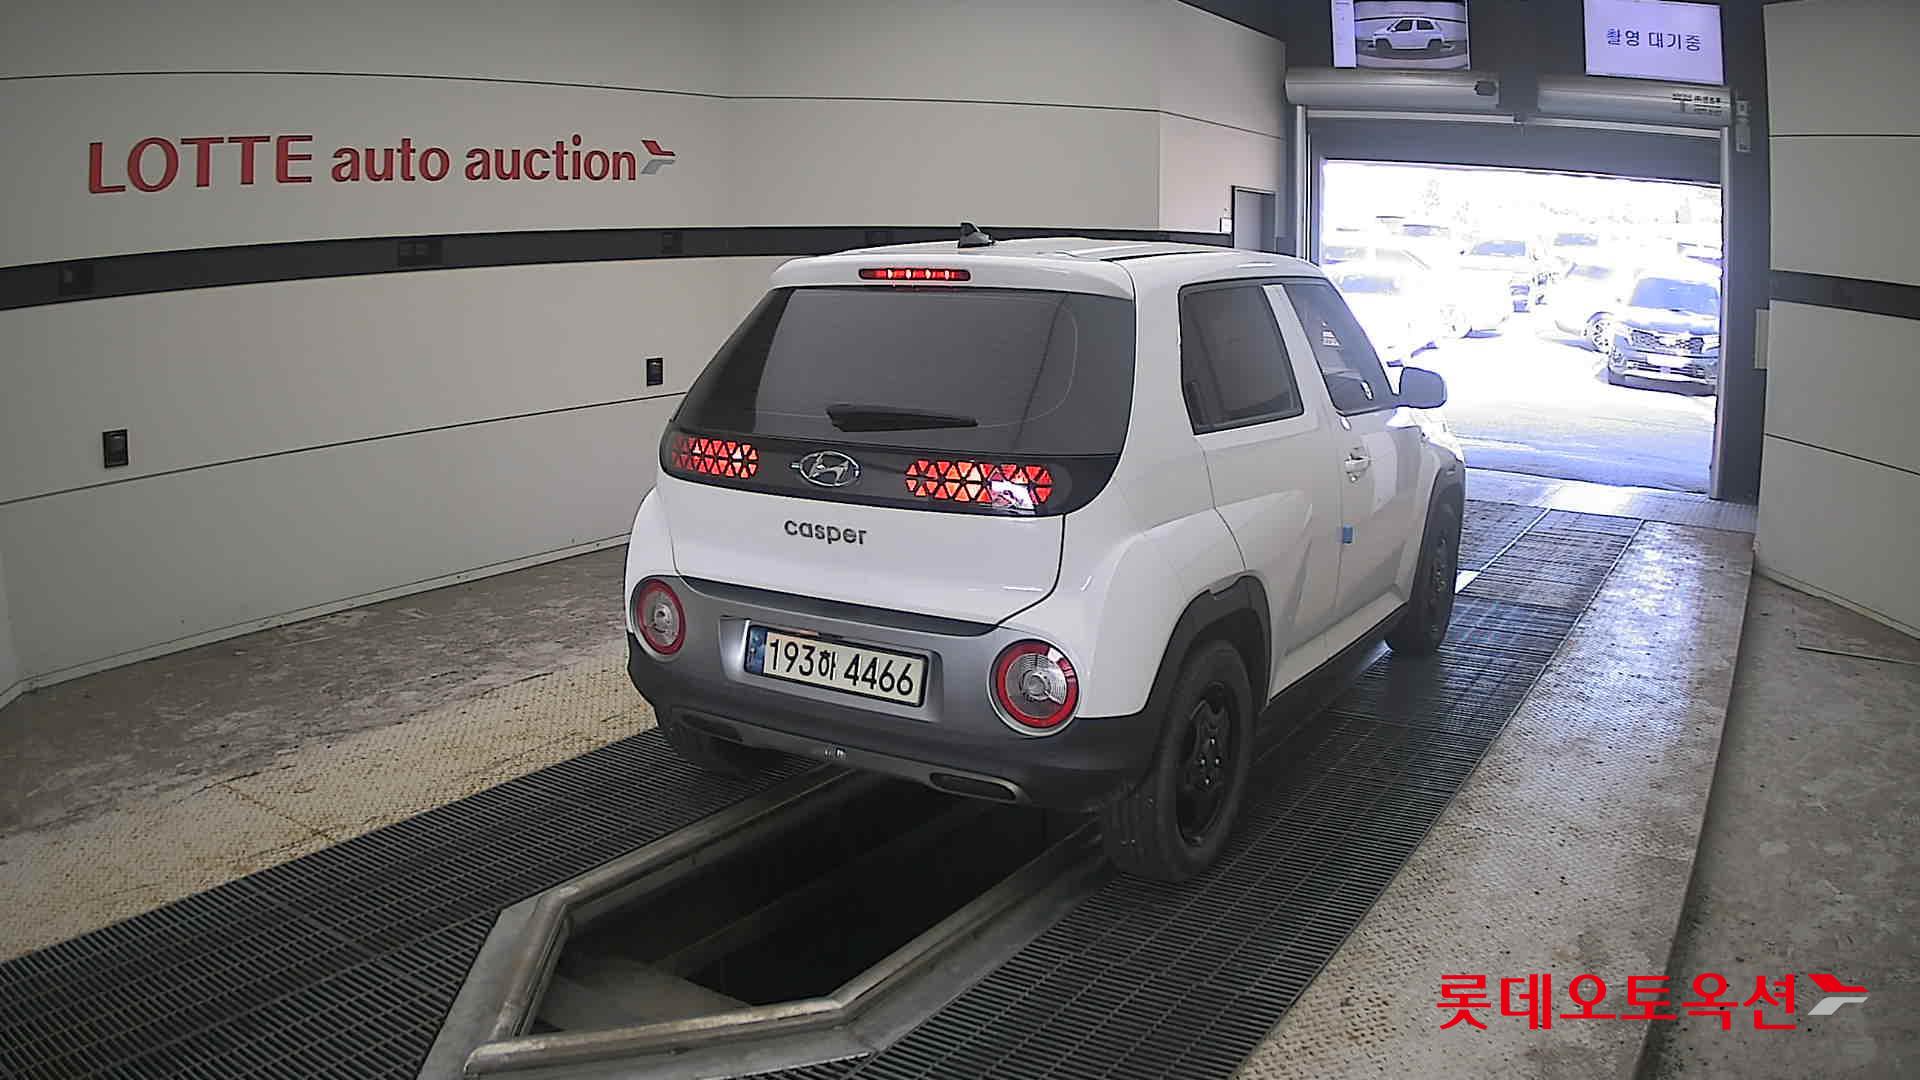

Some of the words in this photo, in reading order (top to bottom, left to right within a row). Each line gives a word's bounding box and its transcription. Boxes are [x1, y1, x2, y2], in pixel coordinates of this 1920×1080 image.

[1648, 31, 1702, 52] 대기중
[87, 134, 314, 194] LOTTE
[330, 137, 450, 183] auto
[463, 133, 637, 182] auction
[784, 520, 867, 545] casper
[769, 638, 836, 681] 193하
[843, 653, 914, 696] 4466
